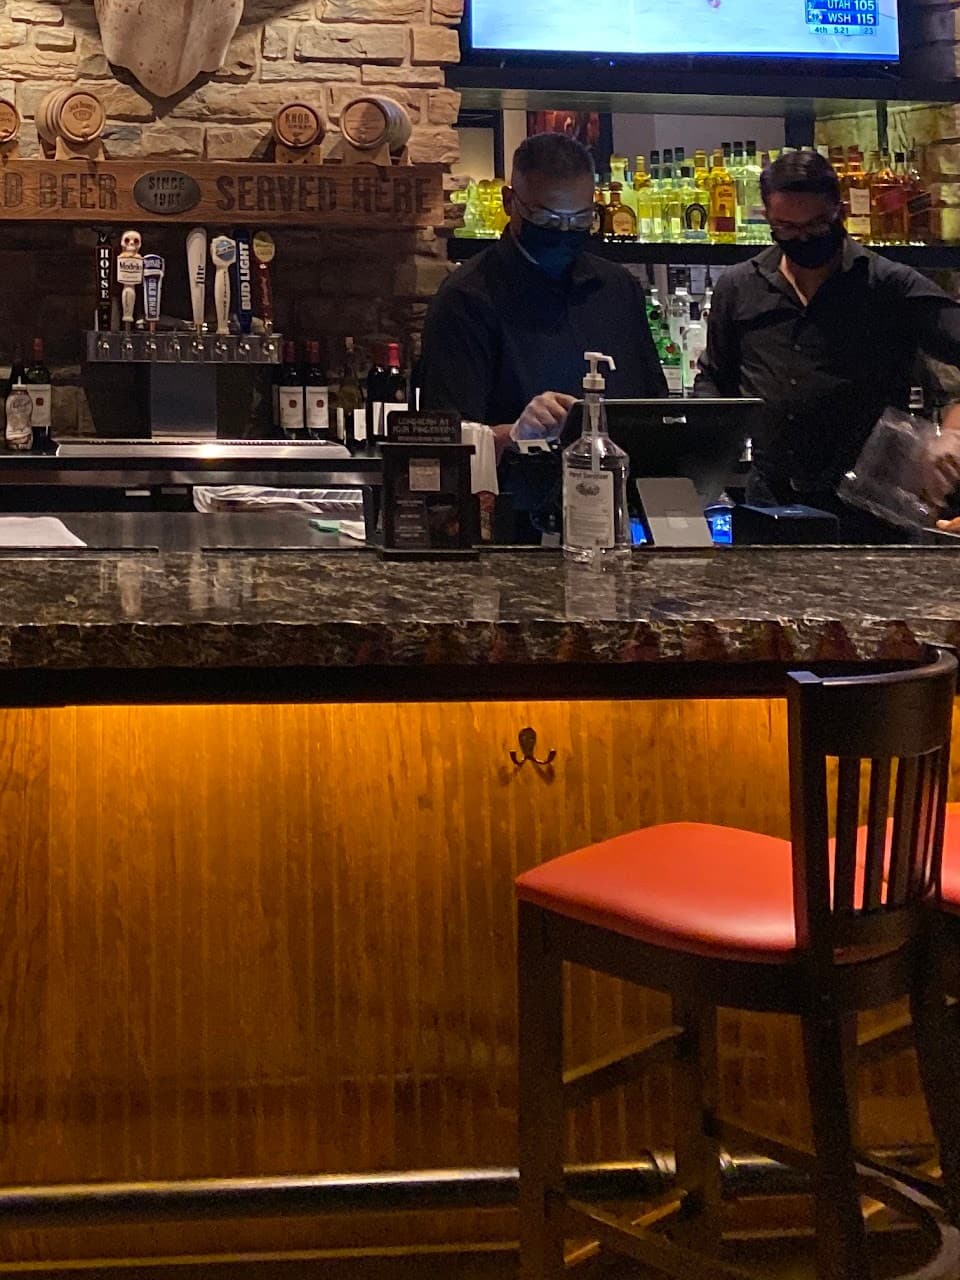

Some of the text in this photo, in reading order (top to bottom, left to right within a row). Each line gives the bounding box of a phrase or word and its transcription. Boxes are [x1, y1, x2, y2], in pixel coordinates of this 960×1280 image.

[827, 0, 875, 11] UTAH 105
[827, 12, 875, 25] WSH 115
[814, 26, 828, 34] 4th
[864, 27, 874, 35] 23
[285, 111, 310, 123] KNOB
[39, 172, 118, 209] BEER
[148, 175, 186, 191] SINCE
[215, 174, 432, 214] SERVED HERE
[100, 248, 110, 299] HOUSE
[239, 241, 252, 311] BUD LIGHT
